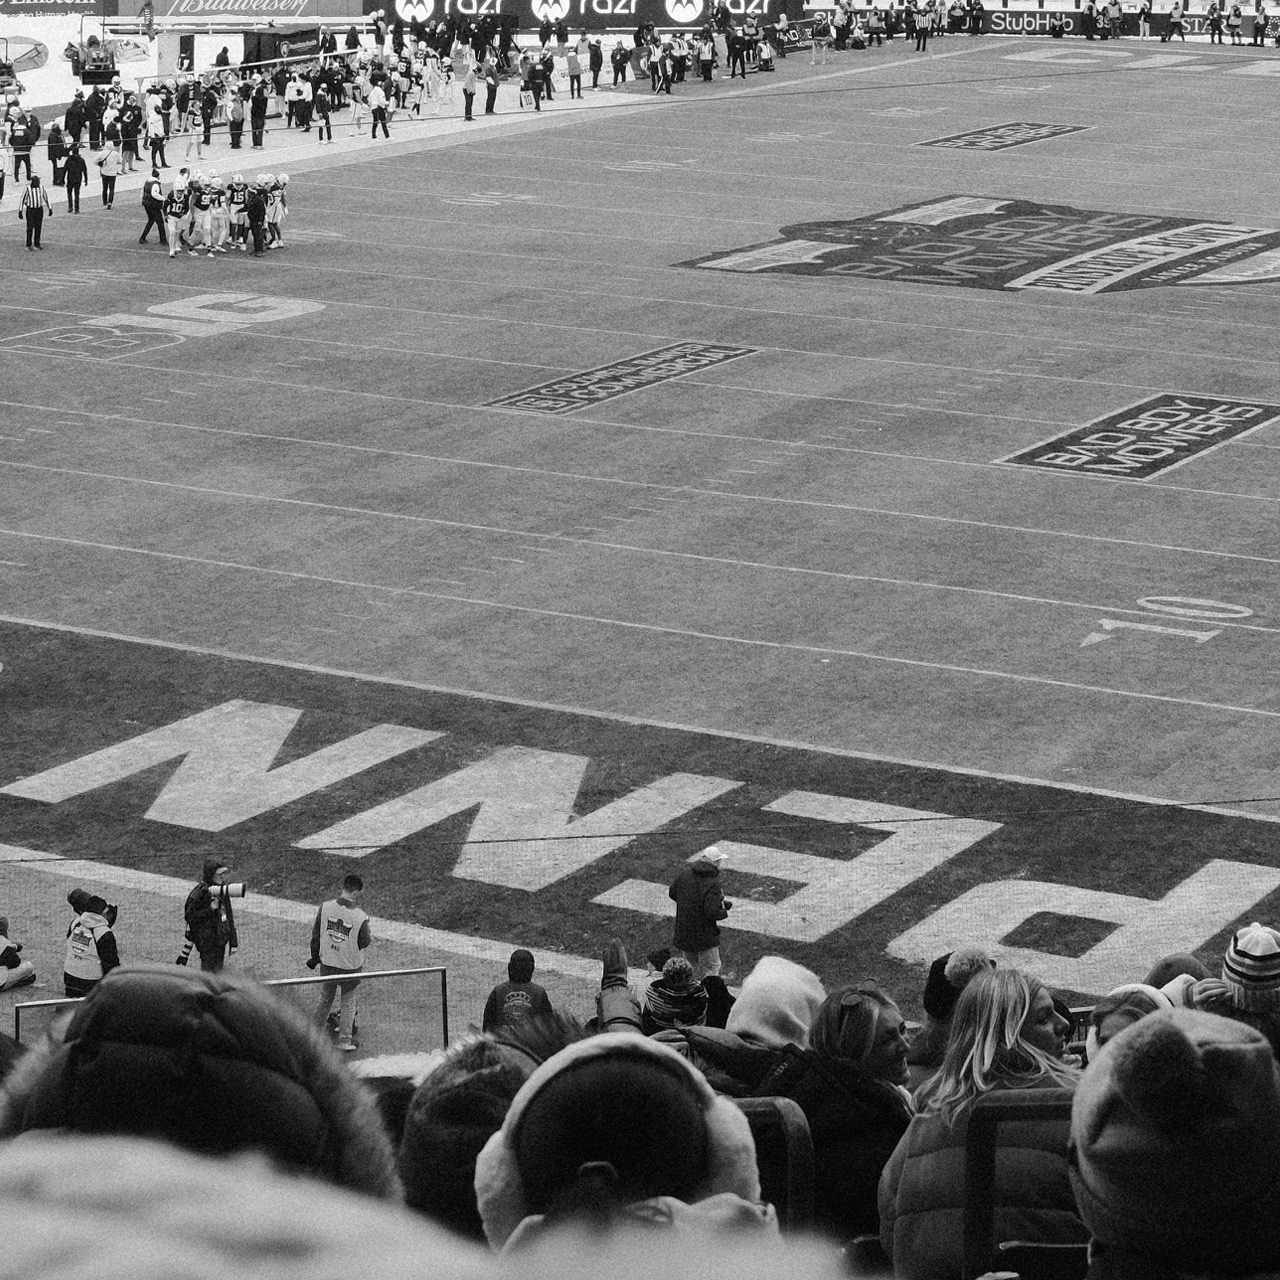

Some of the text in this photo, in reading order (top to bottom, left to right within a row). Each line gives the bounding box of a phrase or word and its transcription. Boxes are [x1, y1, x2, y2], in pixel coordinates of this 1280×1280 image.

[171, 203, 182, 213] 10
[233, 192, 245, 203] 15
[832, 209, 1082, 276] BAD BOY
[895, 214, 1164, 284] MOWERS
[1025, 224, 1261, 291] PINSTRIPE BOWL
[570, 349, 750, 399] COMMERCIAL
[1034, 398, 1209, 468] BAD BOY
[1082, 403, 1265, 473] MOWERS
